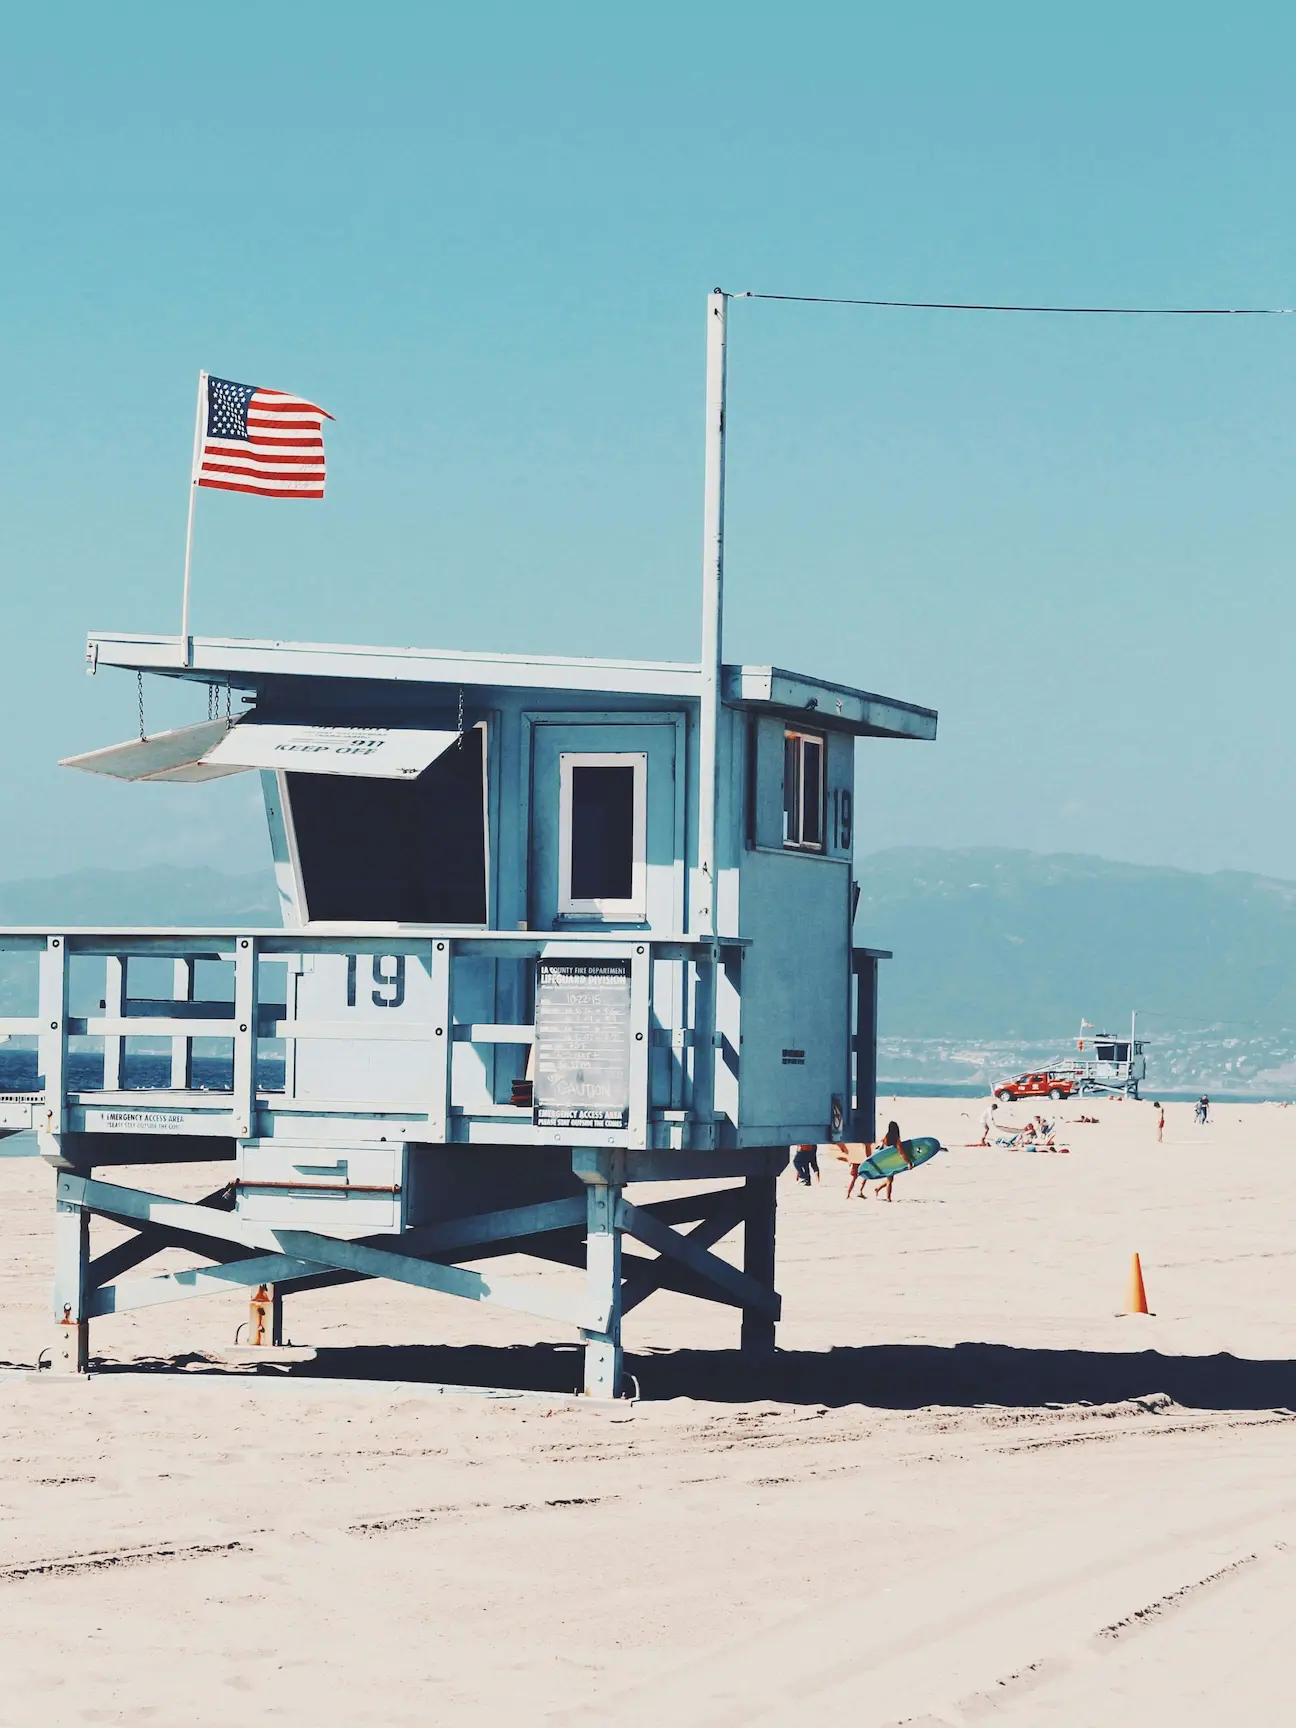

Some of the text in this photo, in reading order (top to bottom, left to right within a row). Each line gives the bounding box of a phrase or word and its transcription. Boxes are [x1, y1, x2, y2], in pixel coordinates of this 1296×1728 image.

[274, 744, 329, 753] KEEP
[834, 788, 852, 850] 19
[549, 966, 573, 974] COUNTY
[588, 967, 626, 975] DEPARTMENT
[345, 954, 405, 1007] 19
[540, 974, 626, 985] LIFEGUARD DIVISION
[557, 1080, 610, 1099] CAUTION
[107, 1113, 142, 1121] EMERGENCY
[144, 1114, 167, 1122] ACCESS
[538, 1109, 622, 1120] EMERGENCY ACCESS AREA
[538, 1118, 557, 1126] PLEASE
[571, 1119, 593, 1127] OUTSIDE
